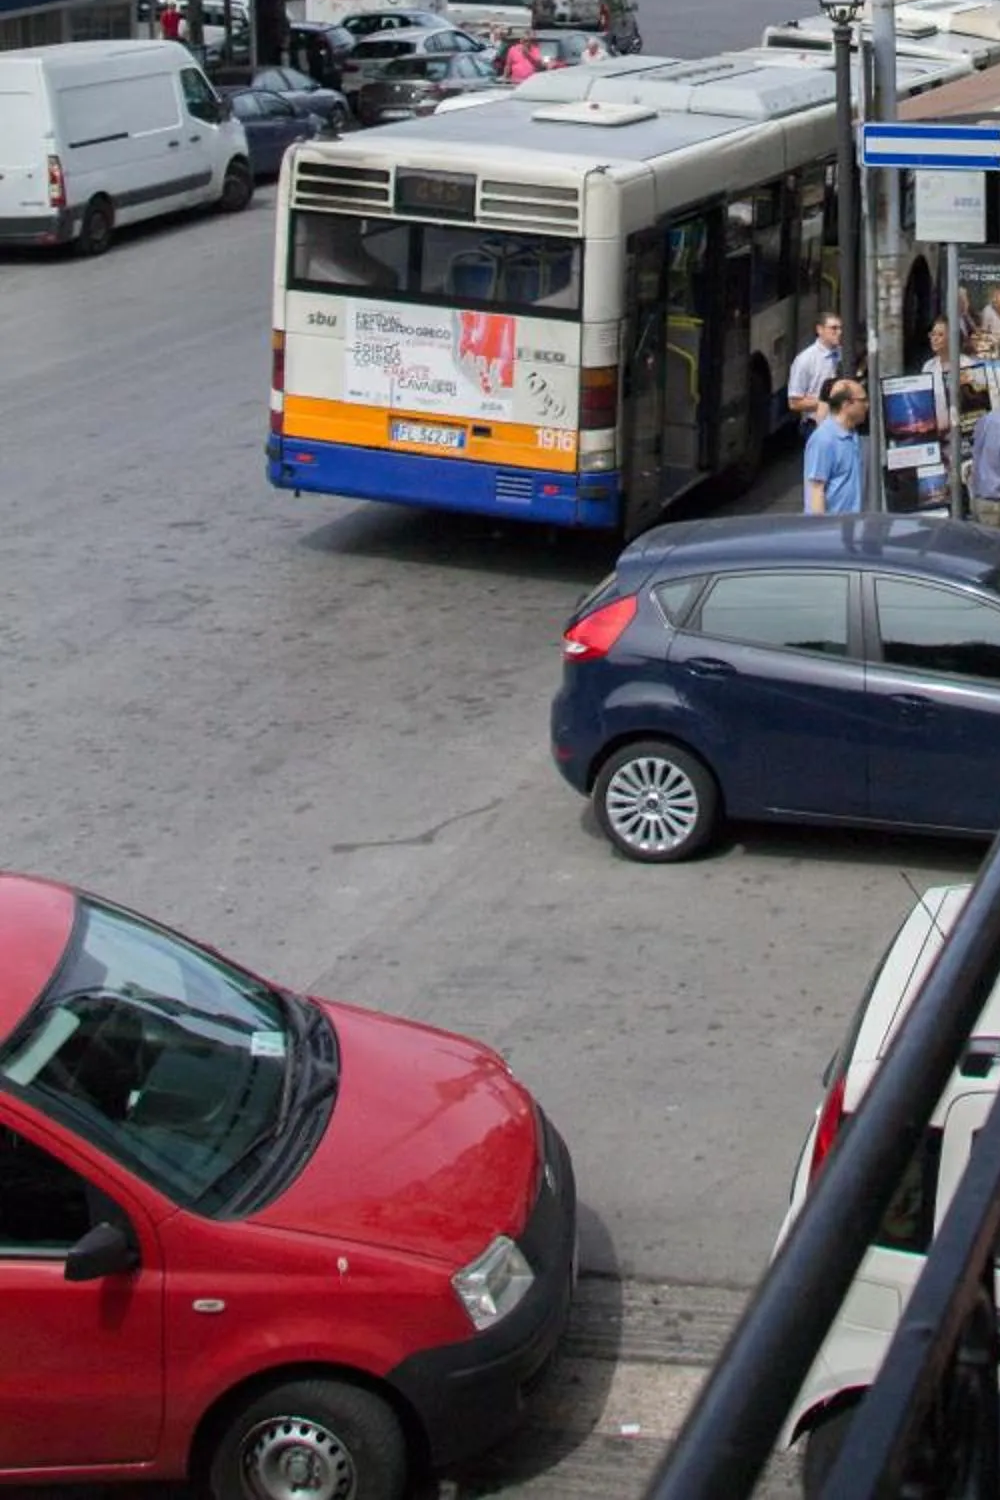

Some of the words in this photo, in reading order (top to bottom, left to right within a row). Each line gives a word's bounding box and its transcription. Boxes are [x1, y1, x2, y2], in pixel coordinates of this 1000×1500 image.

[307, 310, 337, 327] sbu
[415, 327, 451, 340] GRECO
[535, 427, 575, 451] 1916
